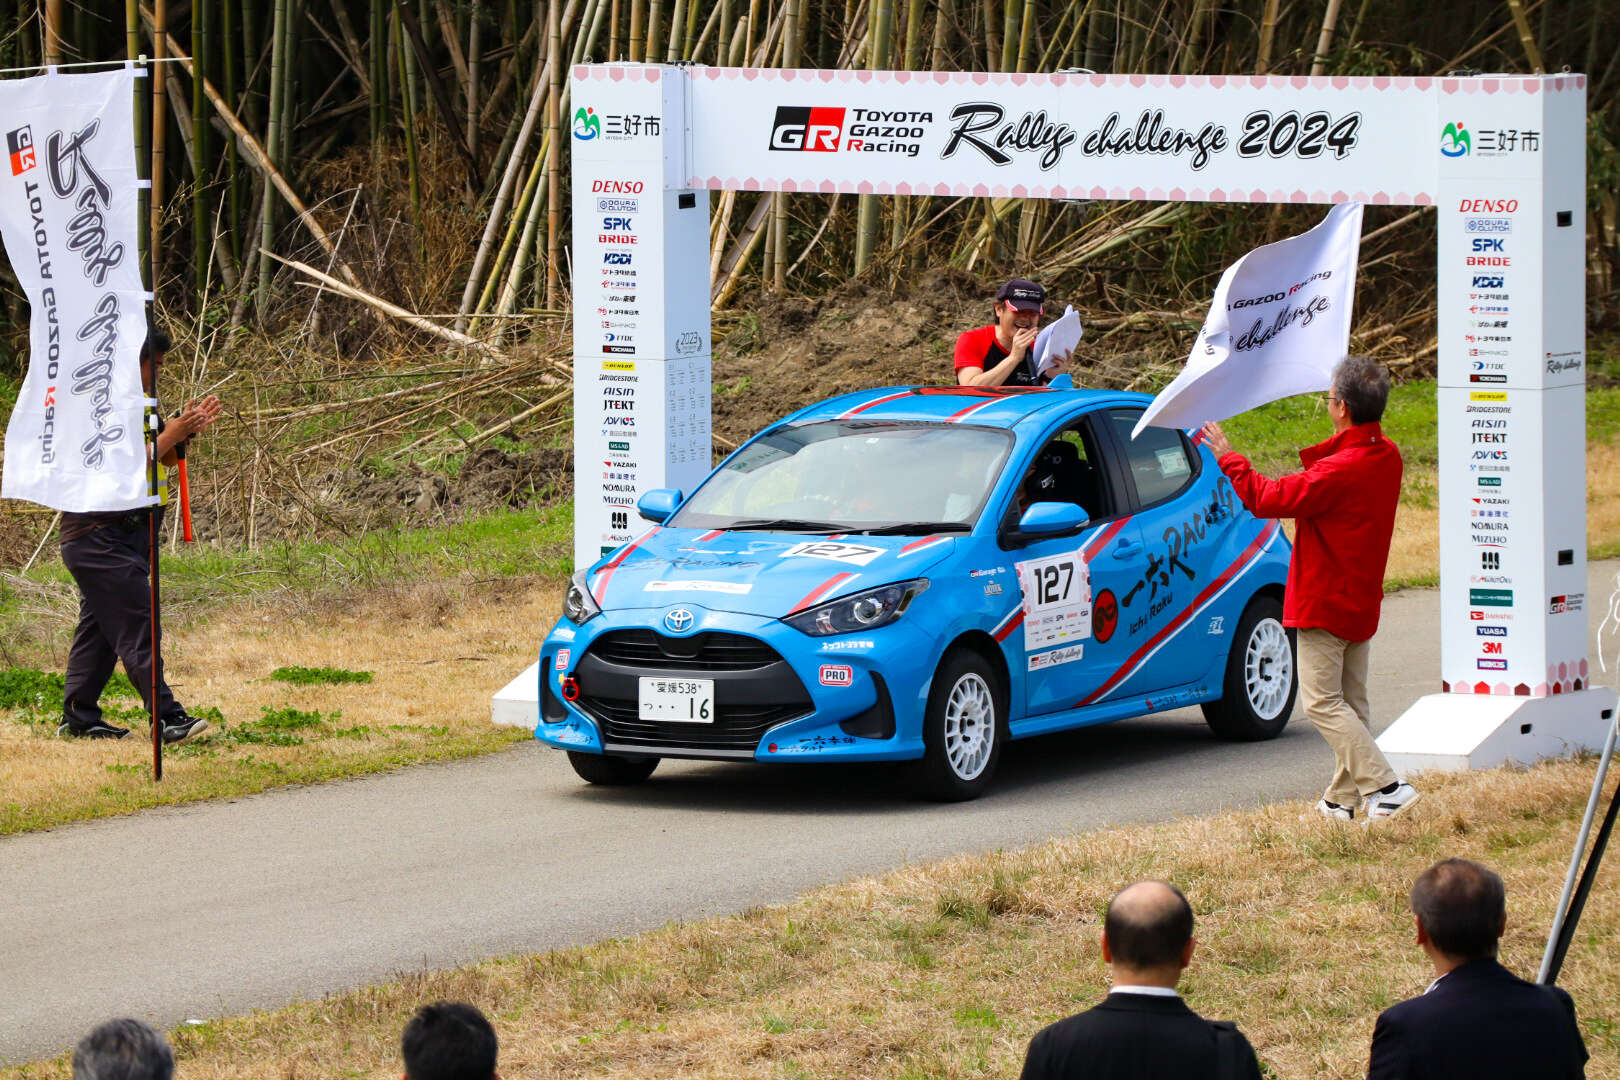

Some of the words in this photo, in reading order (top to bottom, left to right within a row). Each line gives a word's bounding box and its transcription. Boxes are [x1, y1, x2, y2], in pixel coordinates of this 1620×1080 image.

[852, 108, 933, 123] TOYOTA
[606, 115, 661, 136] 三好市
[850, 123, 924, 138] GAZOO
[940, 101, 1076, 171] Rally
[1081, 108, 1228, 171] challenge
[1236, 110, 1362, 160] 2024
[1477, 129, 1540, 152] 三好市
[847, 139, 920, 157] Racing
[591, 180, 644, 194] DENSO
[1458, 199, 1519, 213] DENSO
[603, 217, 632, 231] SPK
[598, 234, 639, 245] BRIDE
[1472, 239, 1504, 252] SPK
[603, 252, 632, 265] KDDI
[1465, 256, 1512, 267] BRIDE
[1472, 276, 1504, 288] KDDI
[1233, 291, 1286, 310] GAZOO
[1288, 270, 1333, 297] Racing
[1236, 295, 1331, 353] challenge
[603, 387, 635, 397] AISIN
[603, 400, 635, 411] JTEKT
[1465, 405, 1512, 413] BRIDGESTONE
[603, 416, 636, 426] ADVICS
[1472, 419, 1507, 429] AISIN
[1472, 432, 1508, 444] JTEKT
[1472, 450, 1508, 460] ADVICS
[602, 484, 636, 493] NOMURA
[602, 496, 634, 505] MIZUHO
[1471, 522, 1509, 530] NOMURA
[1471, 535, 1507, 543] MIZUHO
[792, 543, 858, 559] 127
[1034, 562, 1074, 605] 127
[1482, 642, 1502, 654] 3M
[825, 670, 846, 681] PRO
[690, 697, 710, 720] 16
